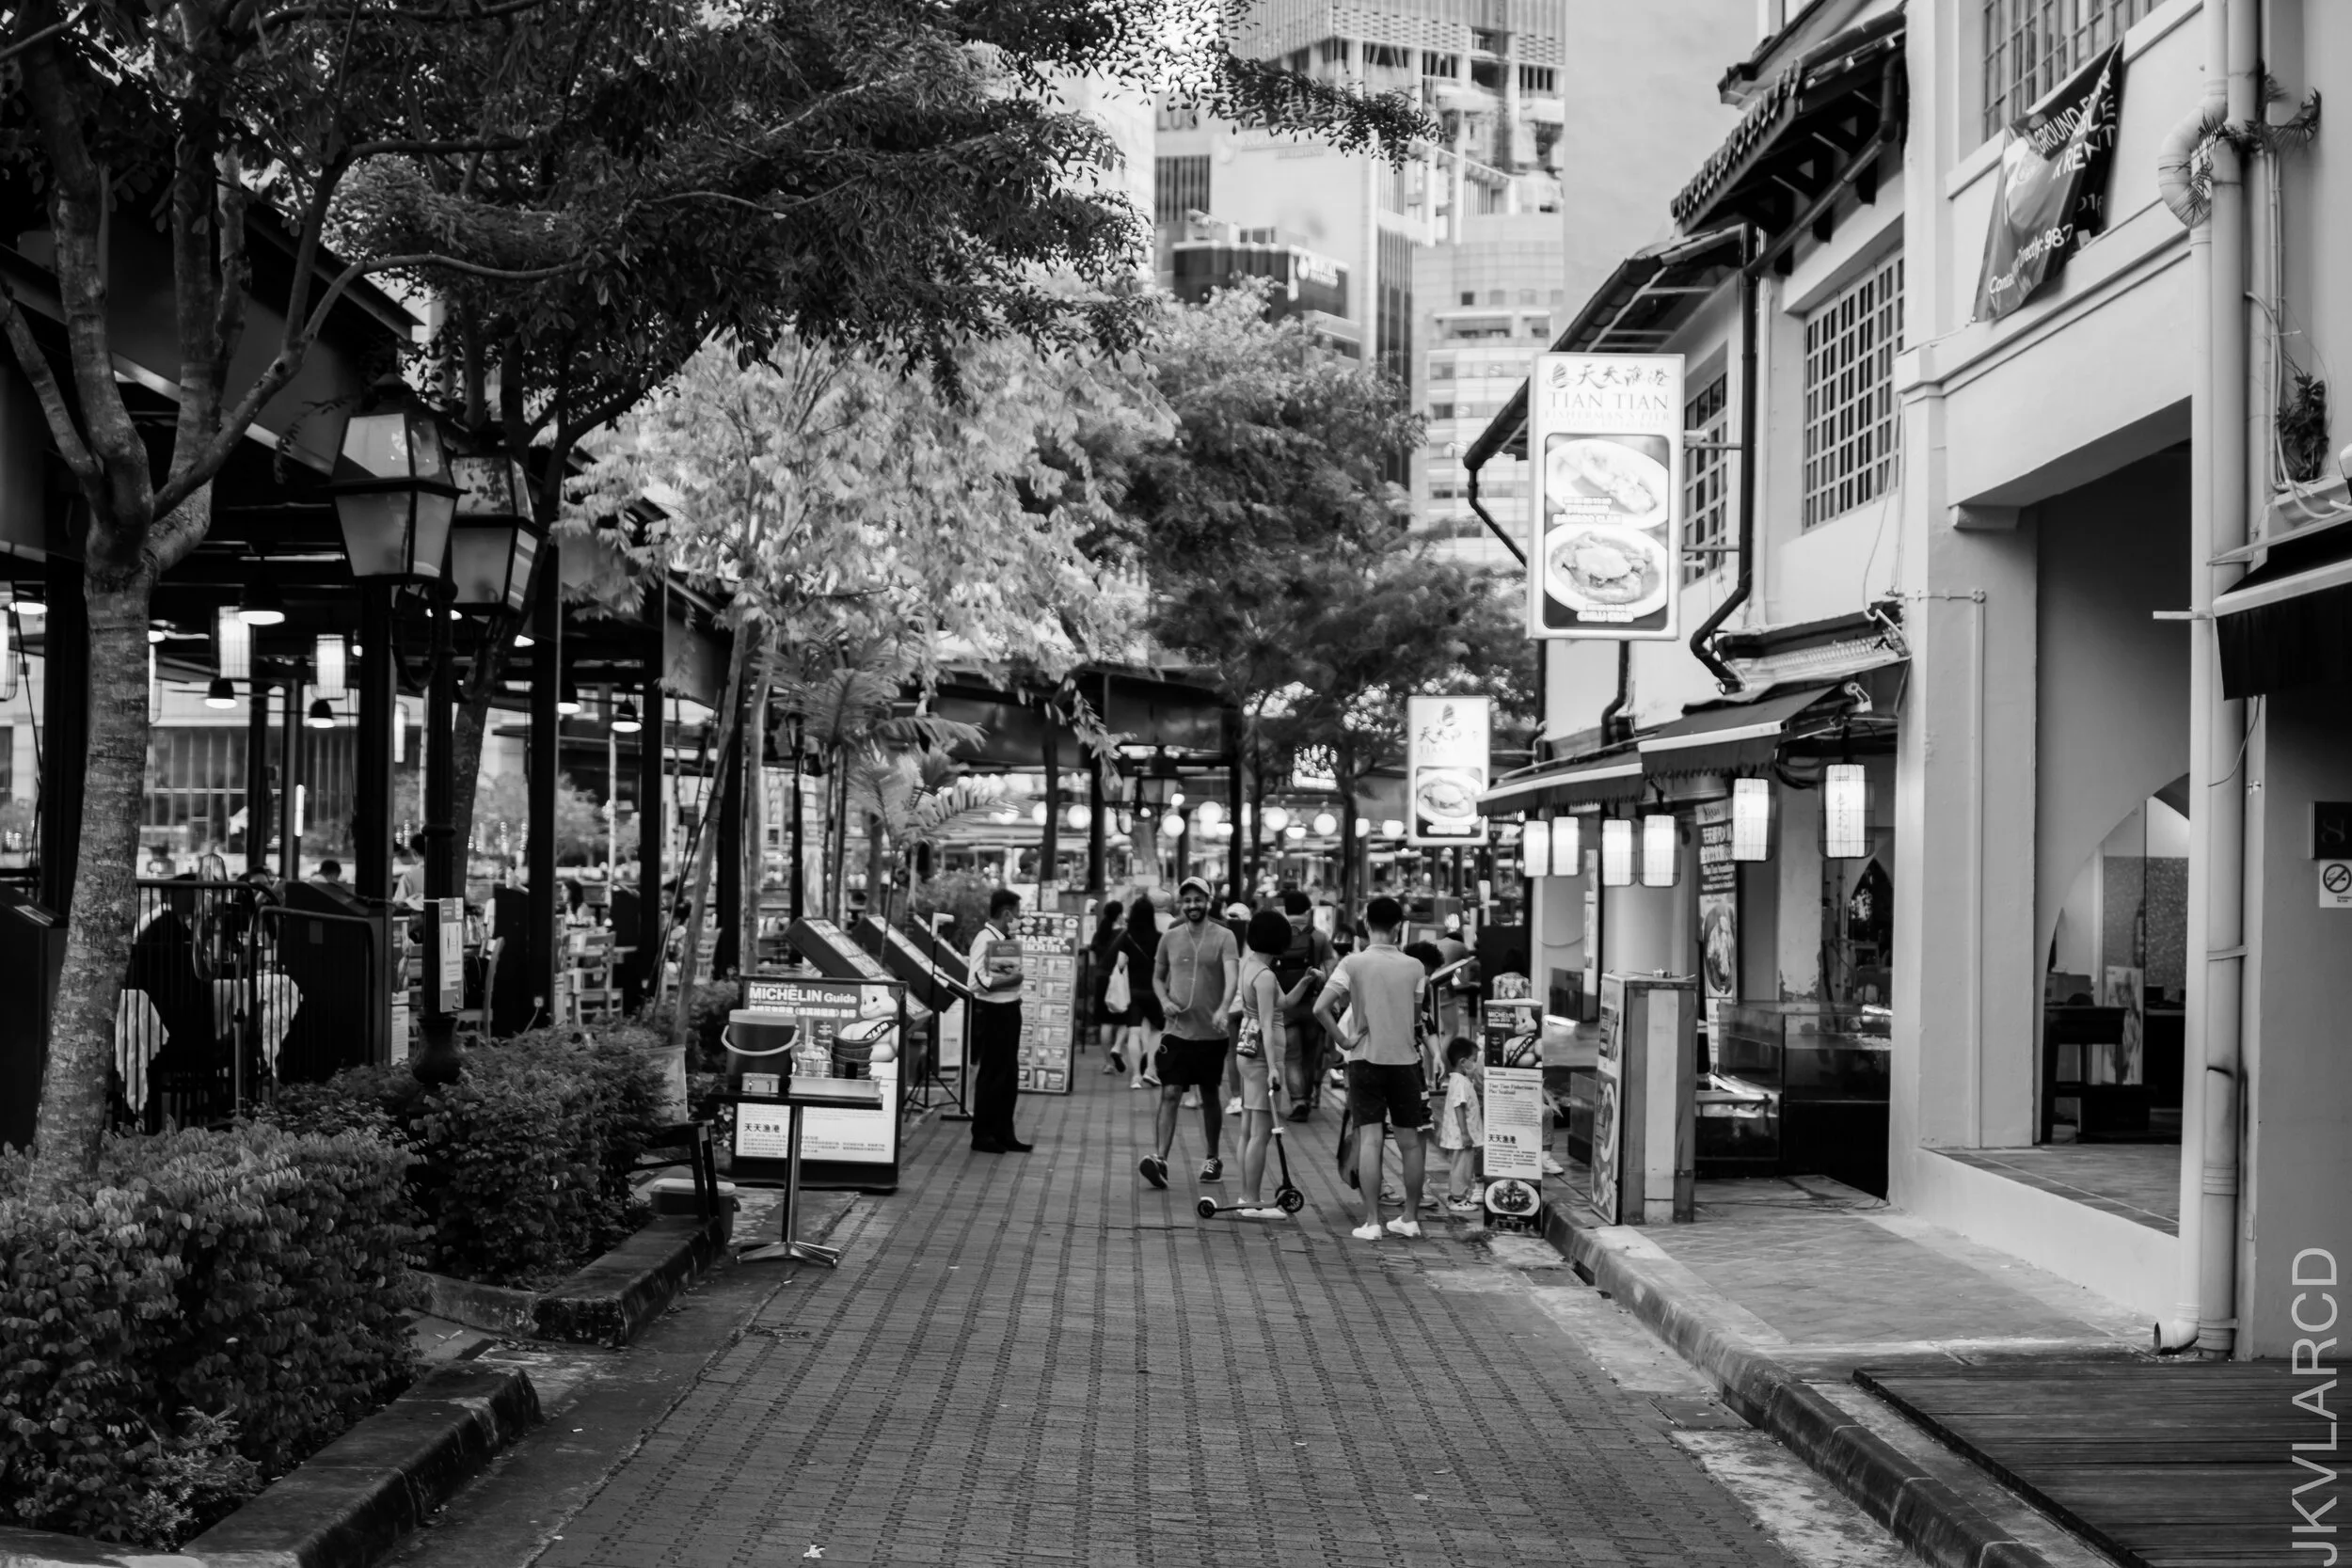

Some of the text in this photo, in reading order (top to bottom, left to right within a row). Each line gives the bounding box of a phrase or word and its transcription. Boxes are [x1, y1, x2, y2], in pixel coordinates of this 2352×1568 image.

[2033, 105, 2082, 154] GROUND
[1549, 391, 1668, 410] TIAN TIAN
[1015, 934, 1066, 944] HAPPY
[1023, 943, 1061, 953] HOUR
[749, 987, 822, 1003] MICHELIN
[824, 992, 857, 1005] Guide
